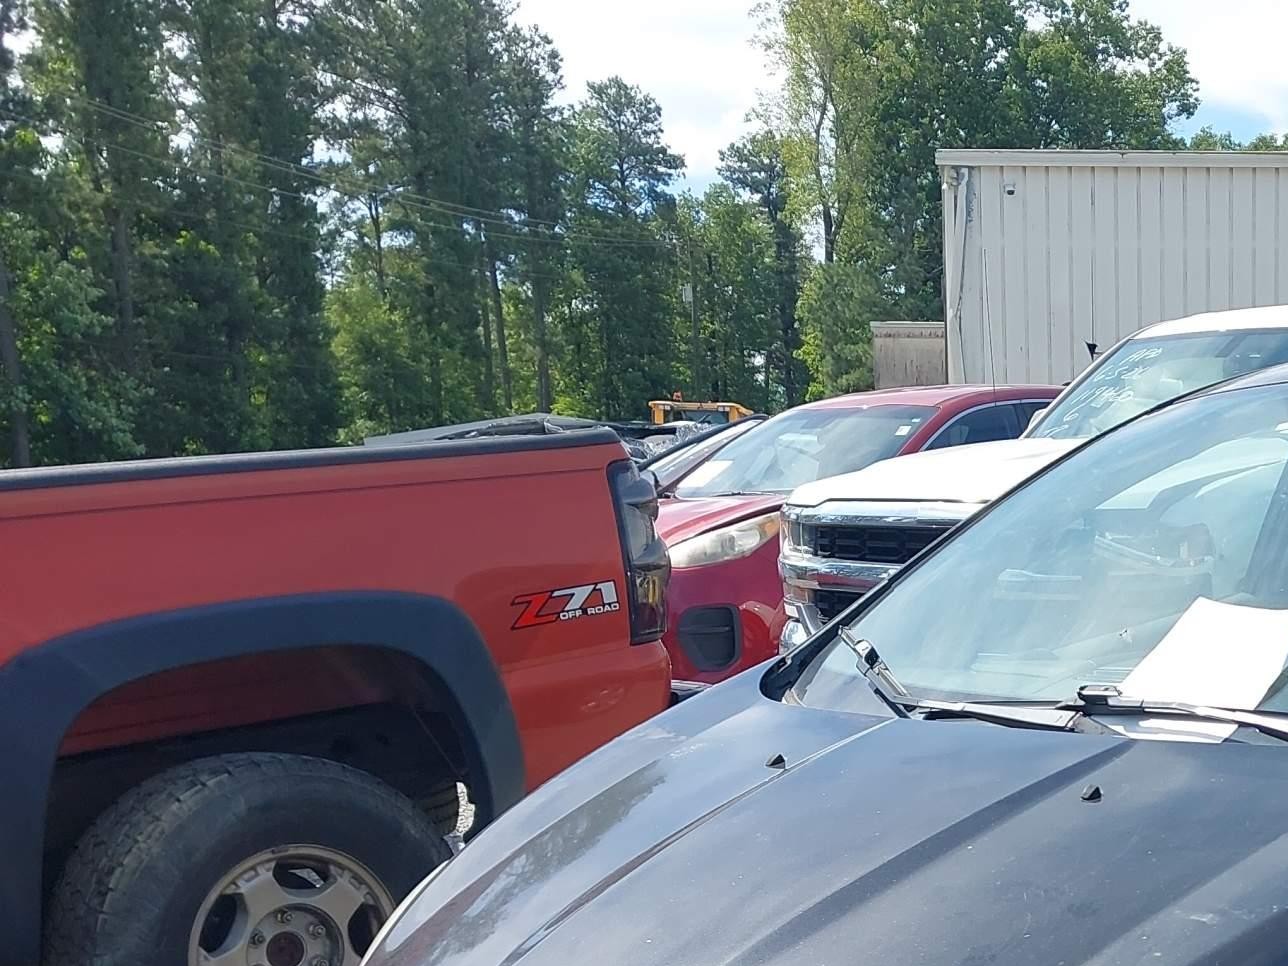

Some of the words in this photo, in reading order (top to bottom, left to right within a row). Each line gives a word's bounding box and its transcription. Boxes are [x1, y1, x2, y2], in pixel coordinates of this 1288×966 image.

[510, 580, 619, 631] Z71
[560, 609, 582, 620] OFF
[587, 603, 619, 615] ROAD
